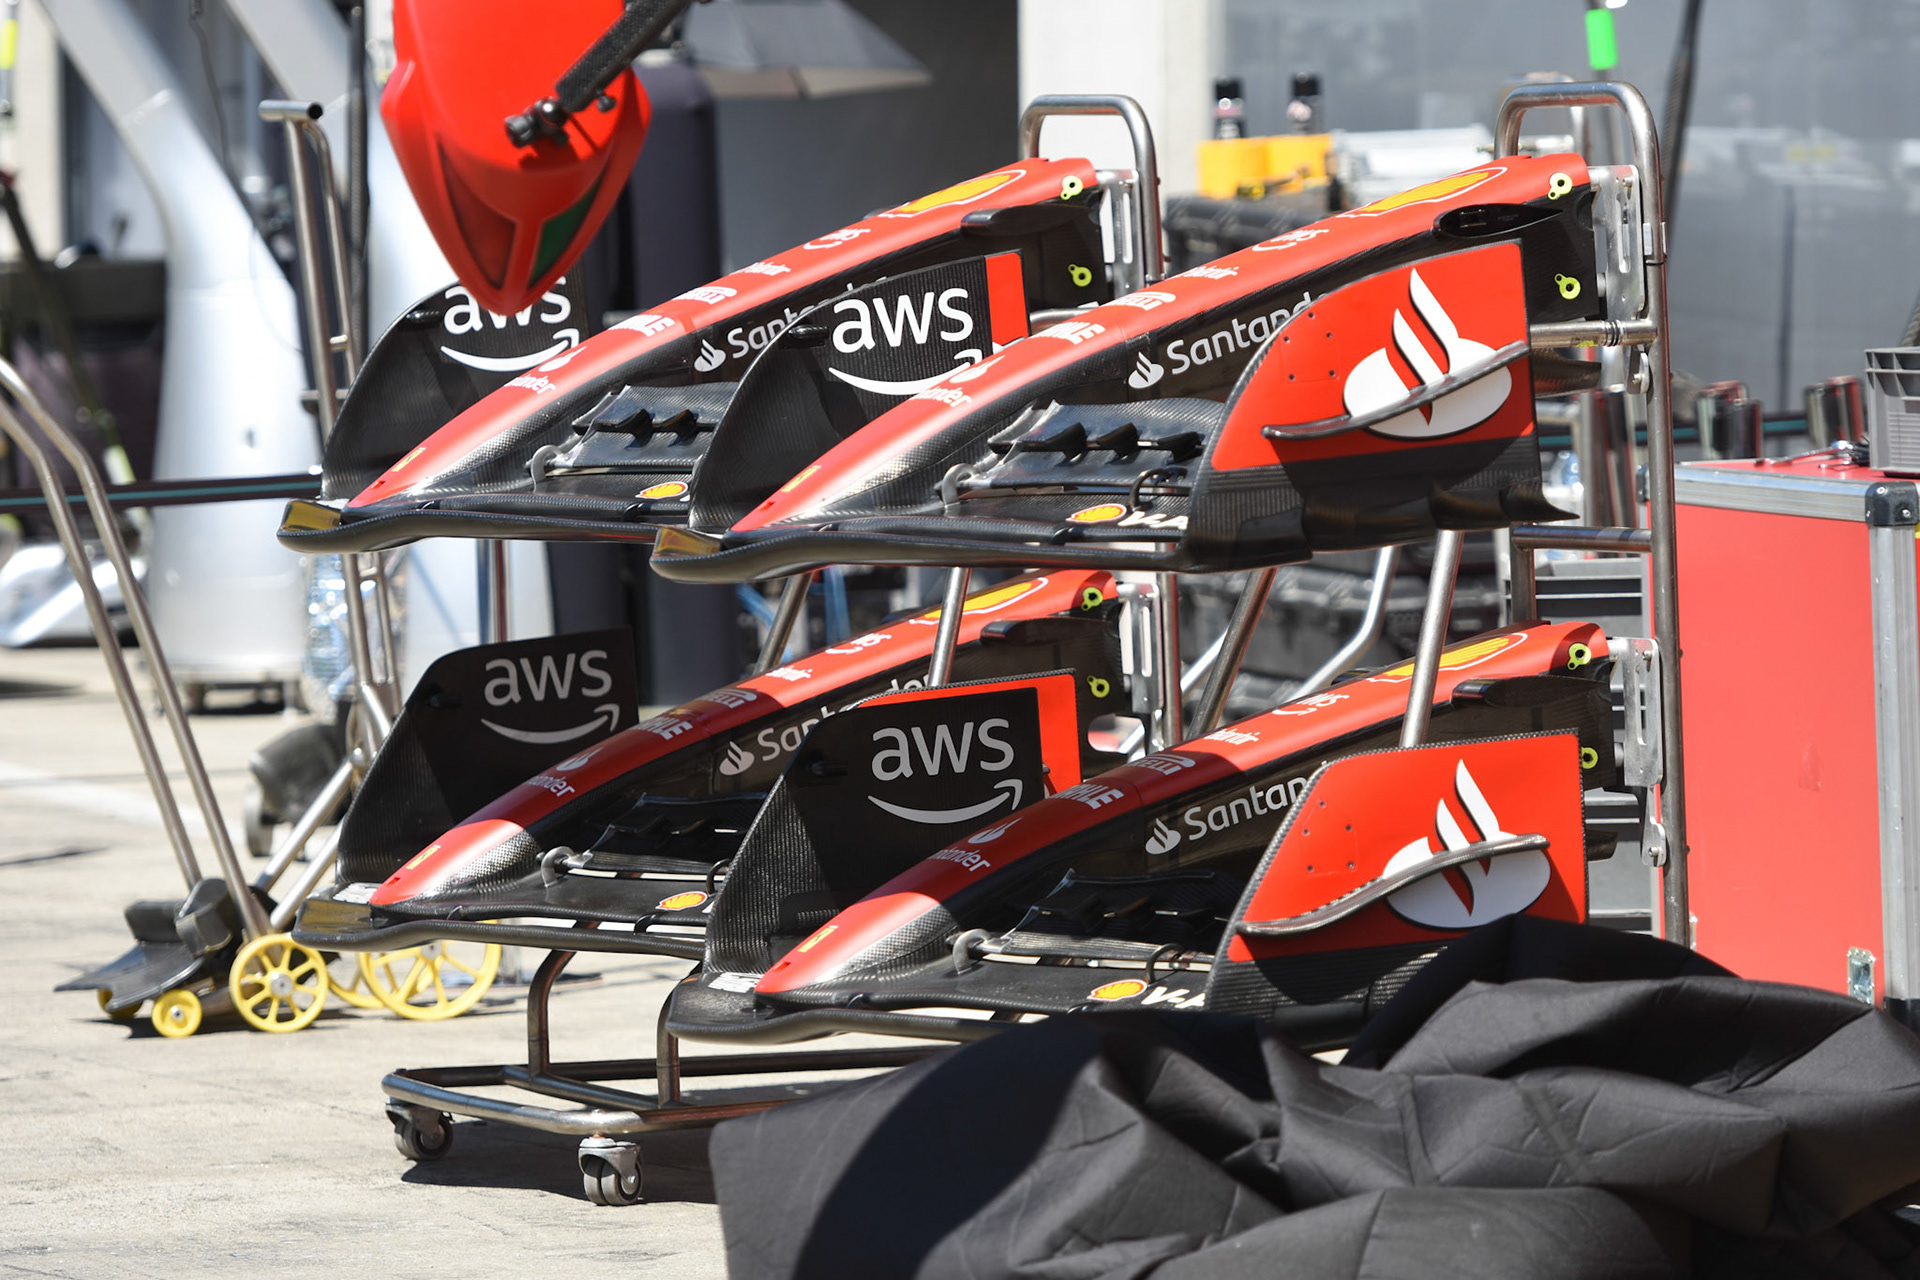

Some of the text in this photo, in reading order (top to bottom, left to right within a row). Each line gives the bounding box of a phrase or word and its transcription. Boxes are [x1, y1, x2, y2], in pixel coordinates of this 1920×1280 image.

[832, 288, 974, 353] aws
[1167, 291, 1327, 375] Santan
[484, 650, 613, 707] aws
[870, 718, 1015, 782] aws
[1184, 776, 1308, 841] Santan
